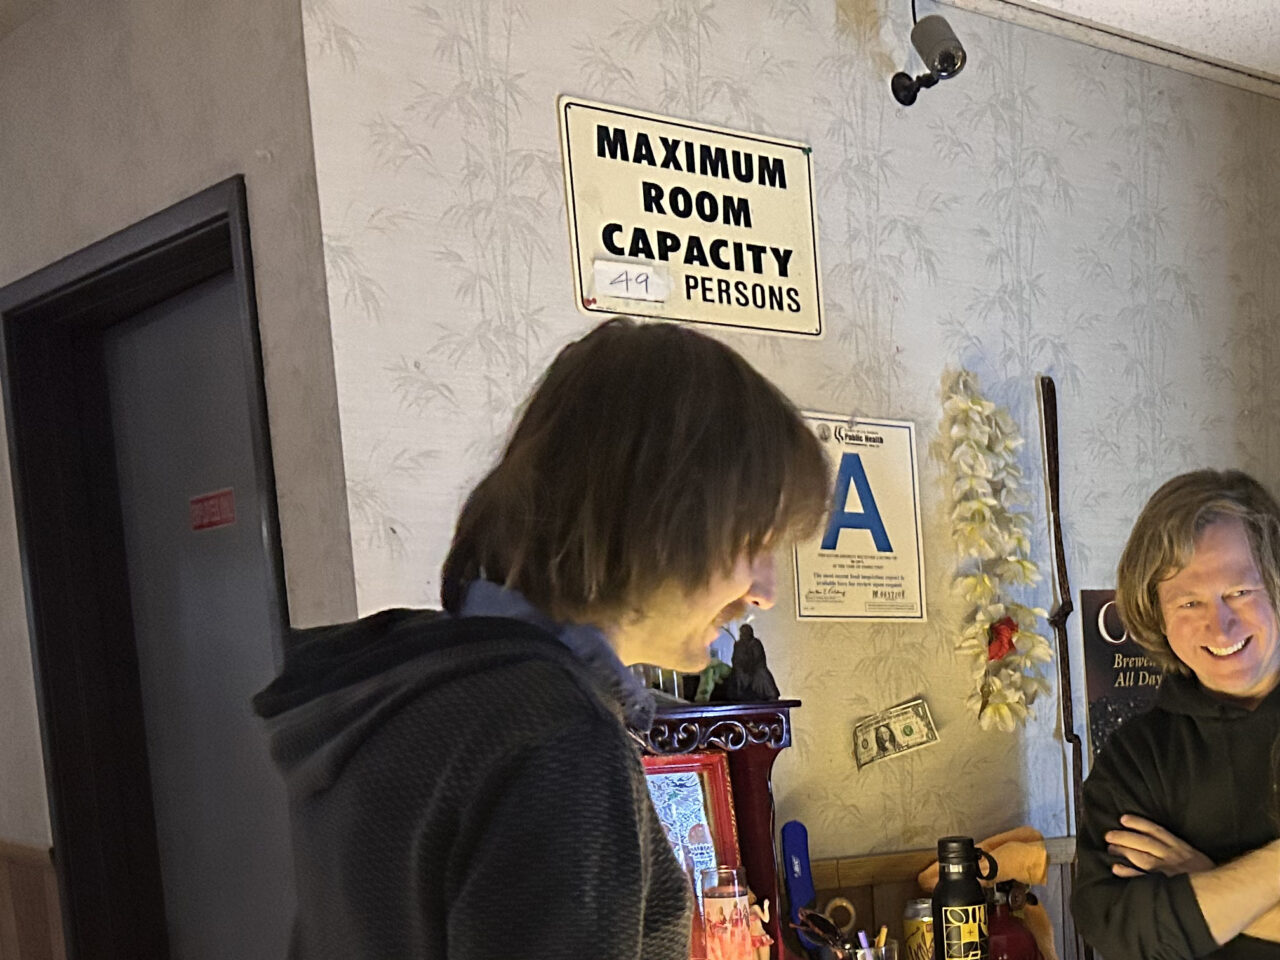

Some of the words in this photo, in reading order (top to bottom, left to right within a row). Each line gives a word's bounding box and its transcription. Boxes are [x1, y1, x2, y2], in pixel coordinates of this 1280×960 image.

[596, 124, 787, 189] MAXIMUM
[642, 181, 752, 228] ROOM
[601, 223, 793, 277] CAPACITY
[609, 270, 650, 294] 49
[684, 274, 801, 313] PERSONS
[864, 435, 884, 444] Health
[821, 452, 893, 552] A
[1113, 653, 1156, 668] Brew
[1114, 672, 1134, 687] All
